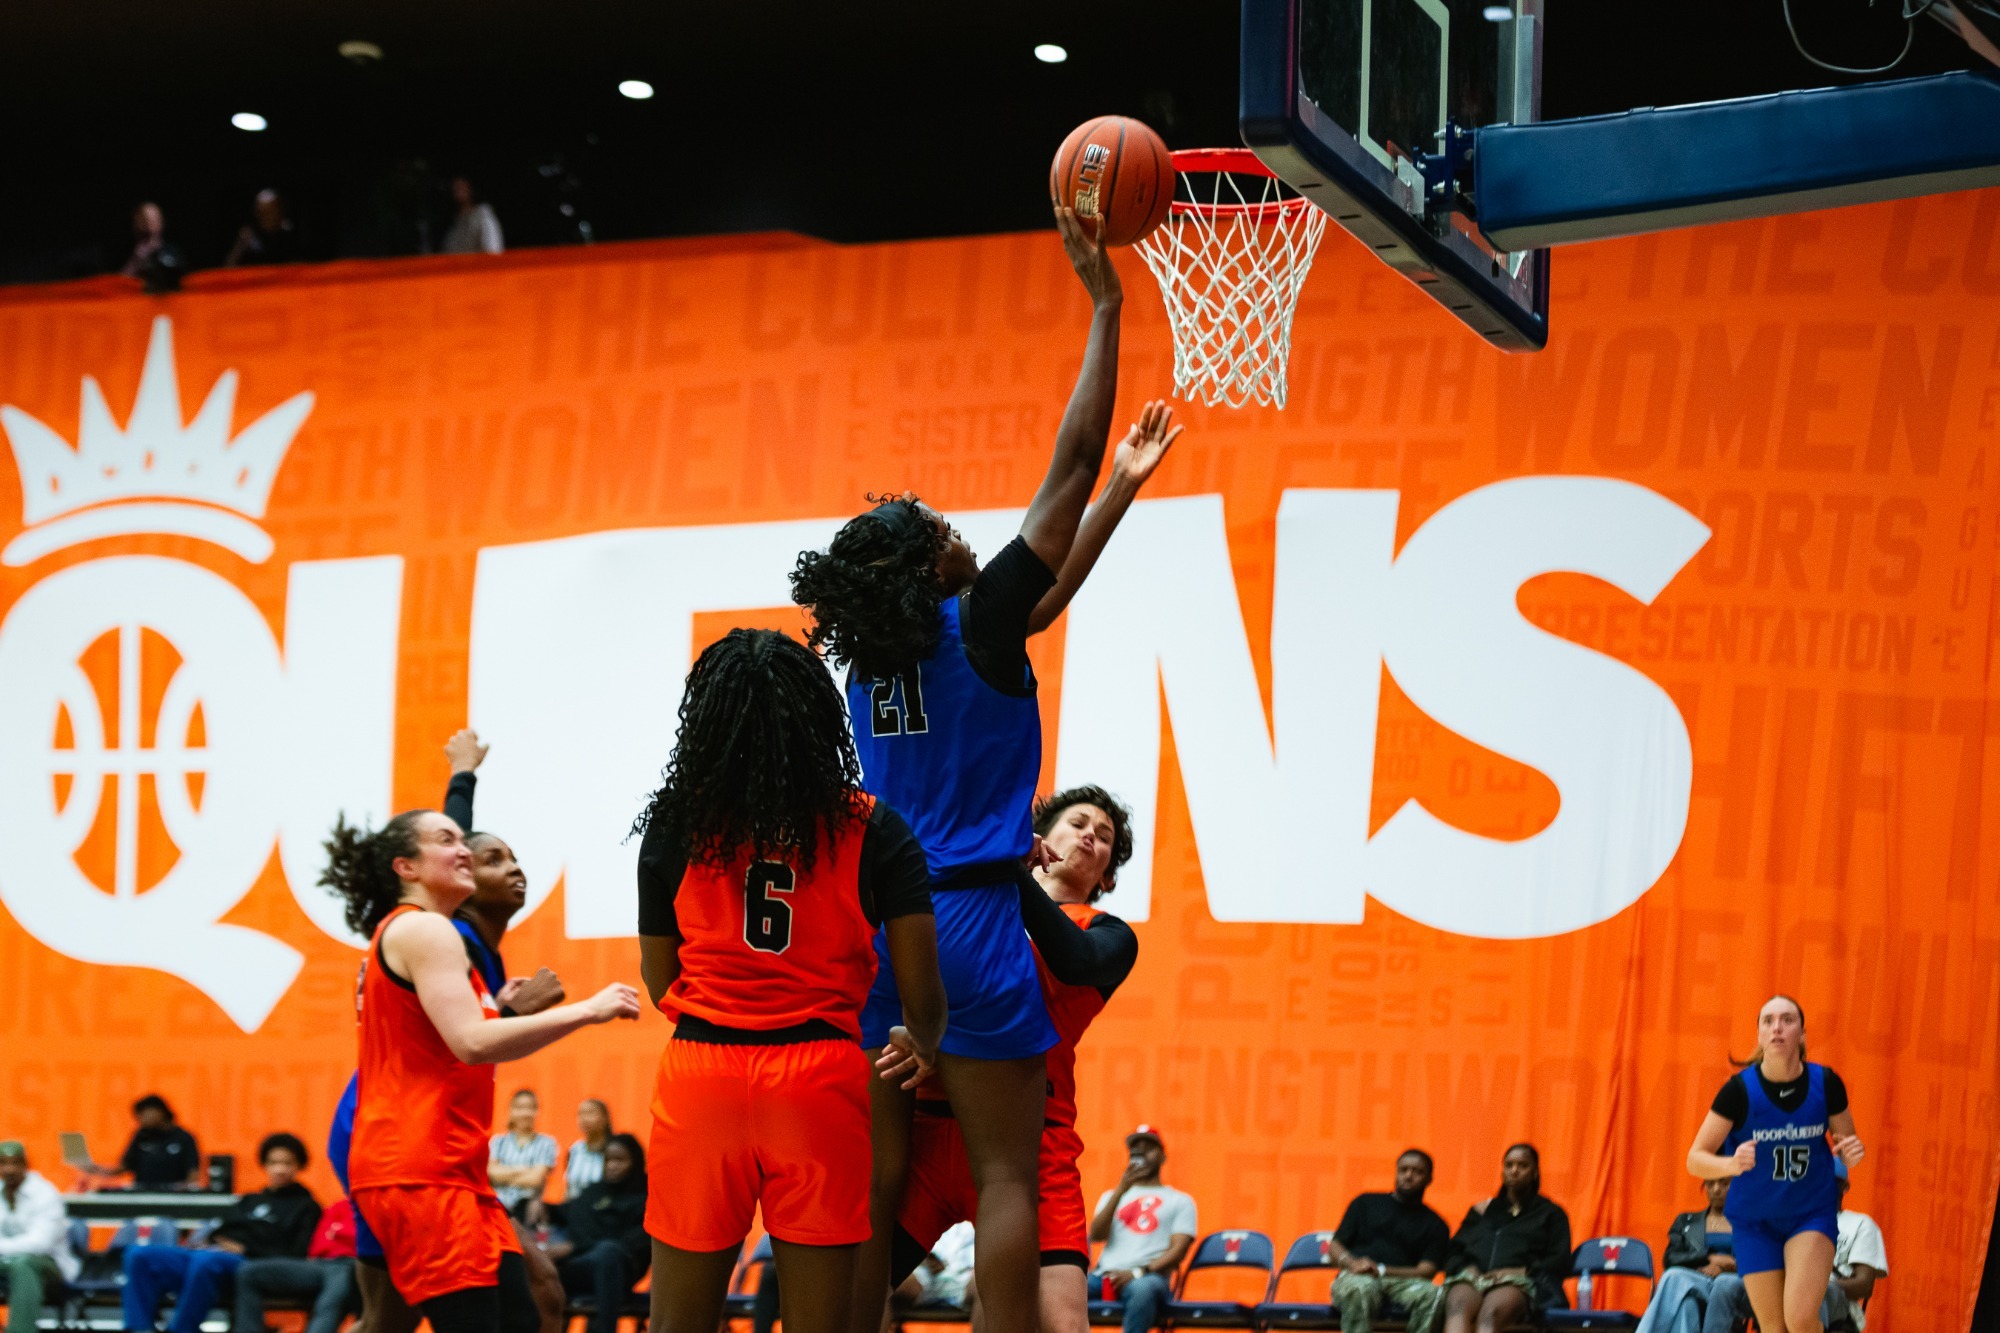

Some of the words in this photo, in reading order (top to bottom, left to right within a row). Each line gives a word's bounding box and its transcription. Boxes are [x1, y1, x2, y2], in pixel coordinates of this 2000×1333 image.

[1075, 143, 1104, 218] ELITE
[515, 257, 705, 383] THE
[896, 350, 1031, 390] WORK
[1495, 322, 1965, 476] WOMEN
[420, 350, 822, 576] WOMEN
[889, 401, 1043, 456] SISTER
[1662, 489, 1928, 597] ORTS
[871, 661, 929, 738] 21
[0, 473, 1710, 1032] QUENS
[743, 858, 795, 956] 6
[1070, 1043, 1407, 1141] RENGTH
[1772, 1145, 1810, 1182] 15
